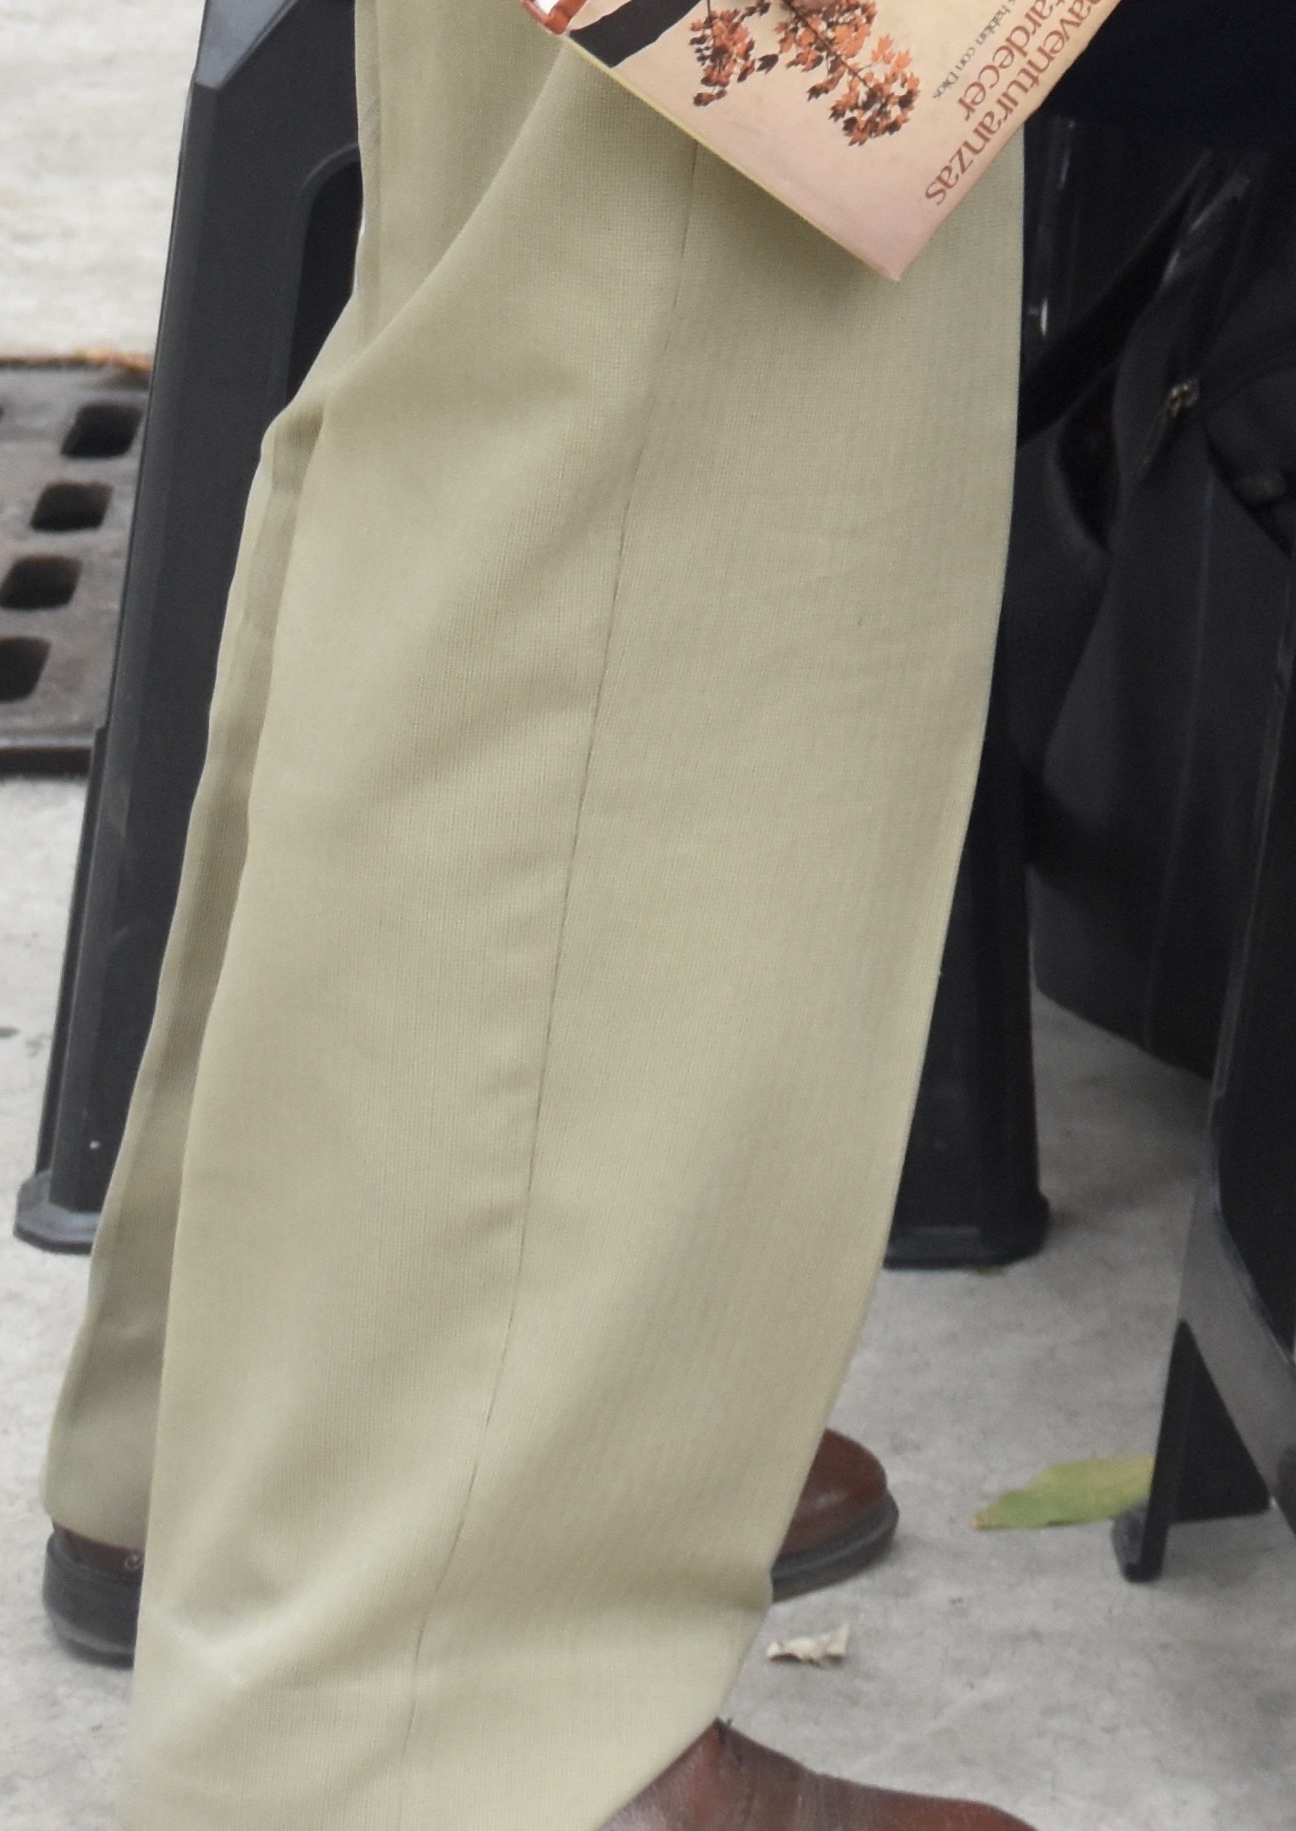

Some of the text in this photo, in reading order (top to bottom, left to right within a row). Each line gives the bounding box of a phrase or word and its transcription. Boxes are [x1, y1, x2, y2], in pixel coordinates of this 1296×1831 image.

[974, 4, 1012, 47] hablan
[954, 46, 976, 72] con
[931, 70, 960, 100] Dios
